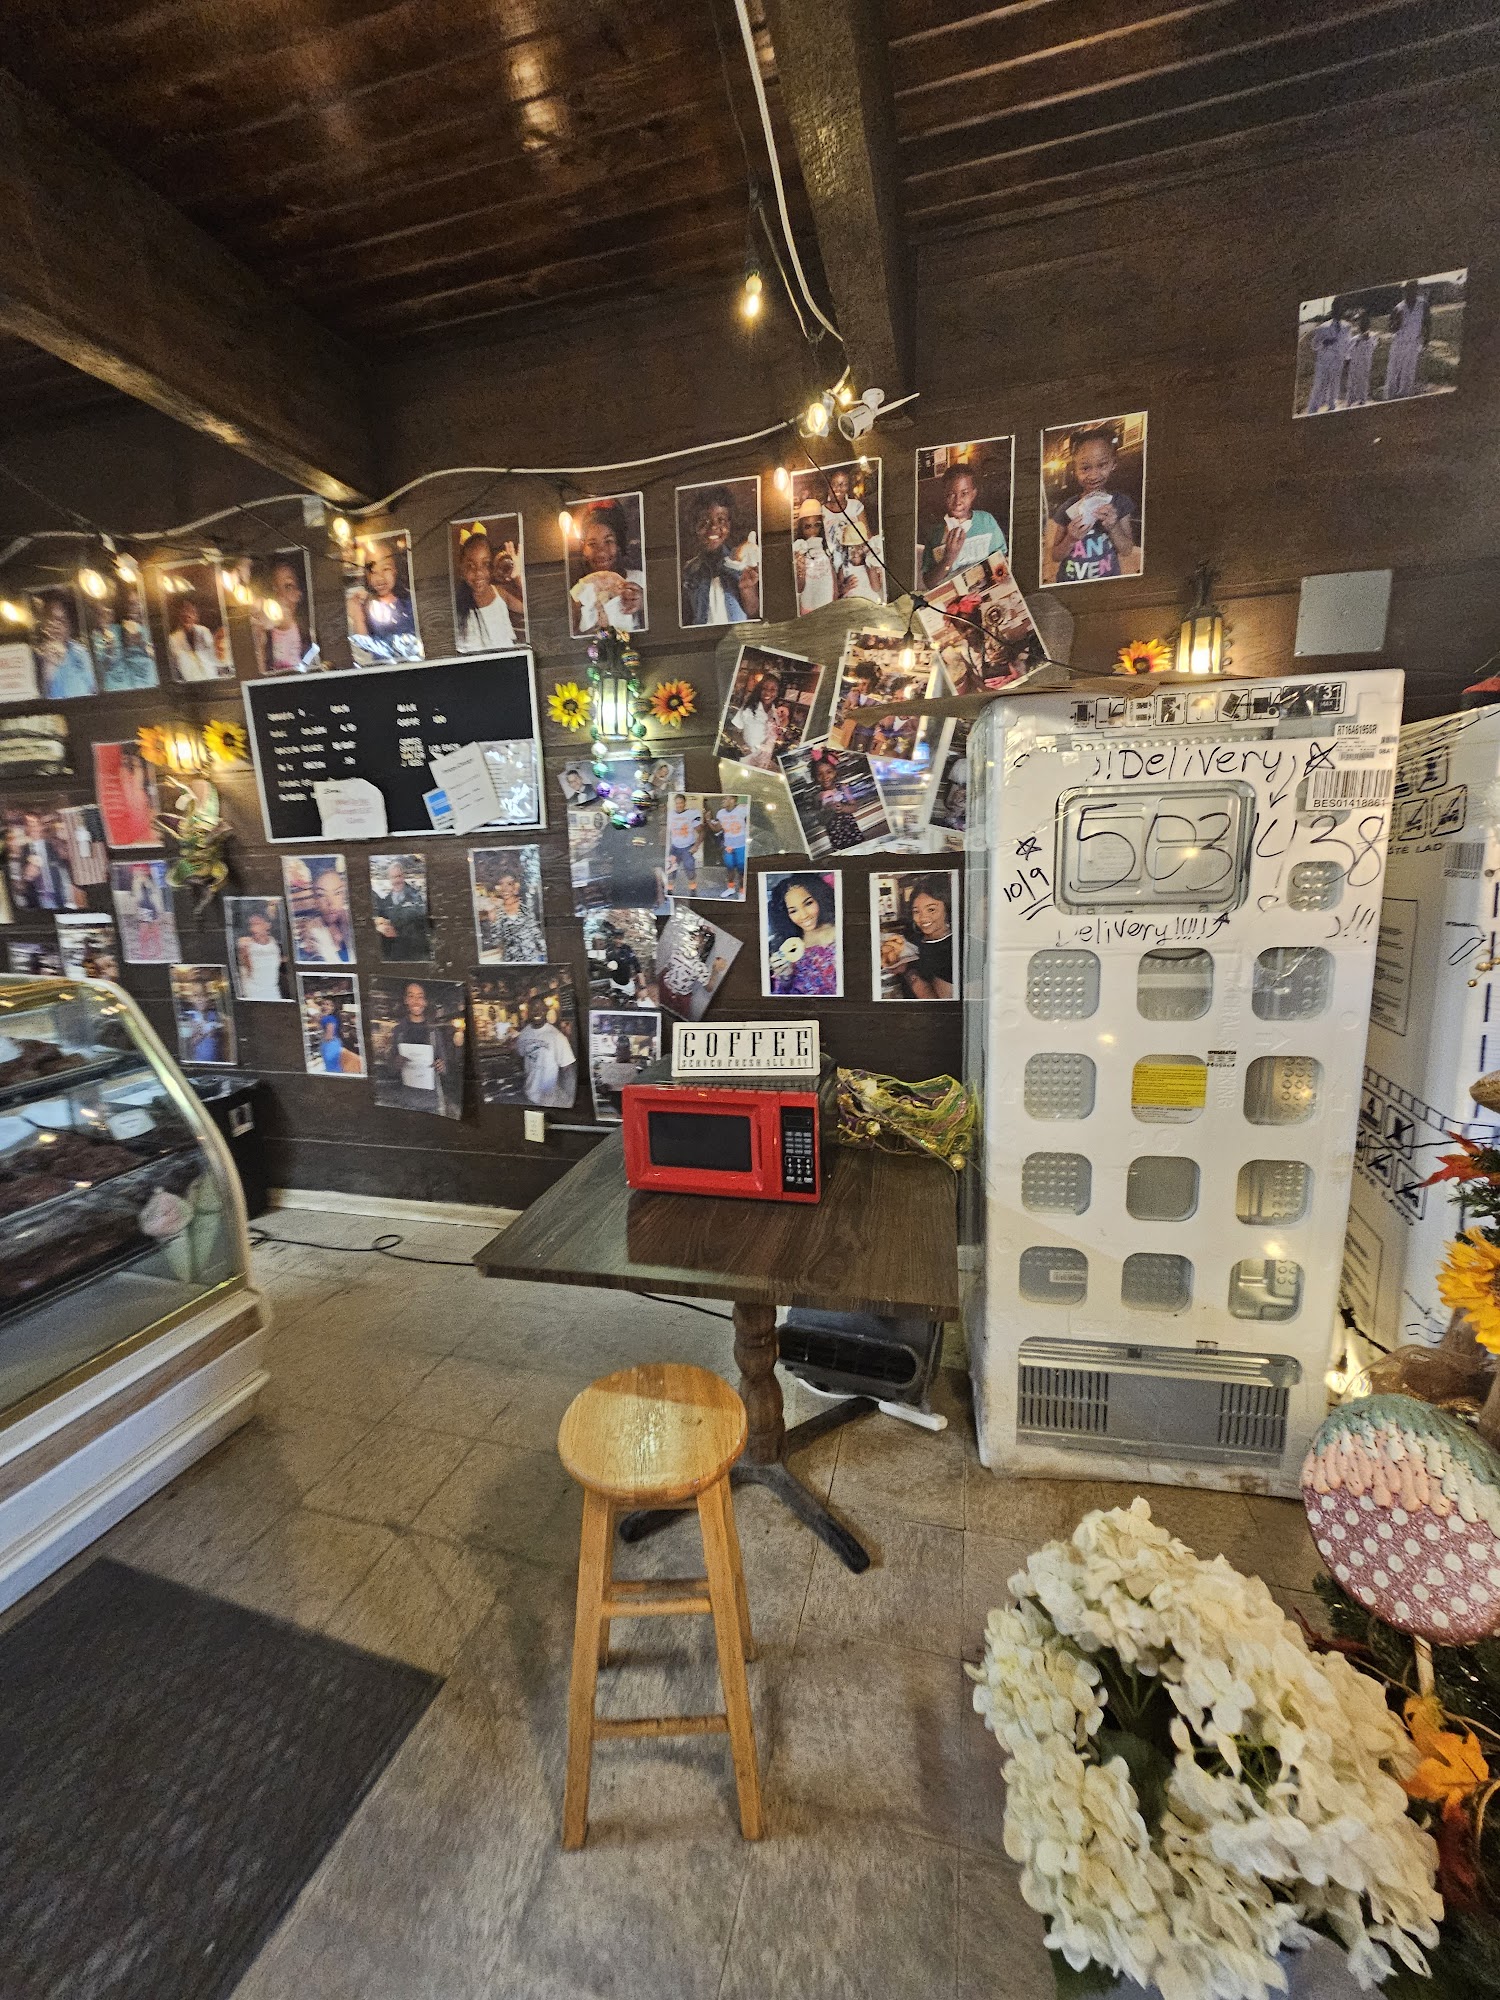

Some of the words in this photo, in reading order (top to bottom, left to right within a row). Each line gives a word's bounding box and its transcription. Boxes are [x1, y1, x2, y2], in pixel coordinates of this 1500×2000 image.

[1003, 867, 1050, 903] 10/9
[684, 1031, 808, 1057] COFFEE
[728, 1059, 760, 1067] FRESH
[766, 1058, 785, 1066] ALL
[790, 1058, 808, 1066] DAY
